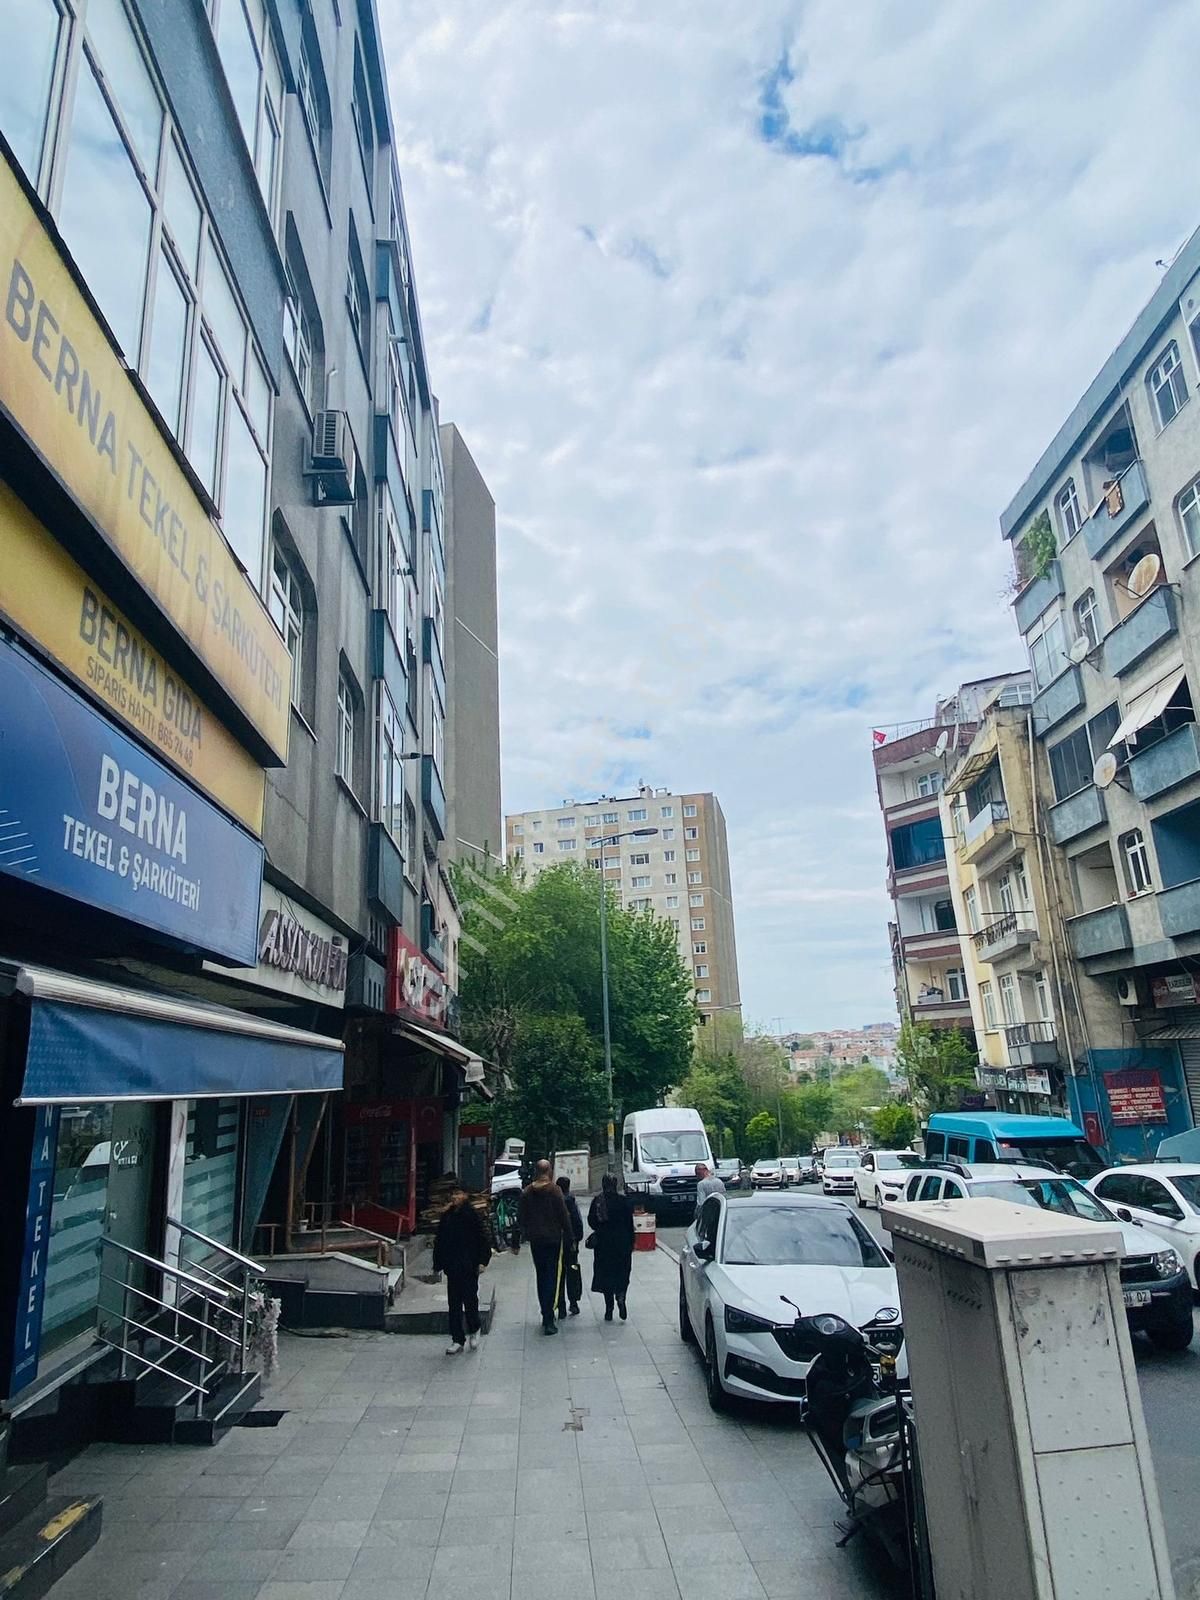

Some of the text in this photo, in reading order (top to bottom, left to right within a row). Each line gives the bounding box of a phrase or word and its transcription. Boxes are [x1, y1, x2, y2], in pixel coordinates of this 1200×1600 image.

[6, 259, 117, 476] BERNA
[127, 440, 190, 584] TEKEL
[195, 554, 208, 607] &
[79, 585, 202, 750] BERNA GIDA
[63, 814, 201, 912] TEKEL & ŞARKÜTERİ
[97, 753, 187, 865] BERNA
[24, 1181, 47, 1350] TEKEL
